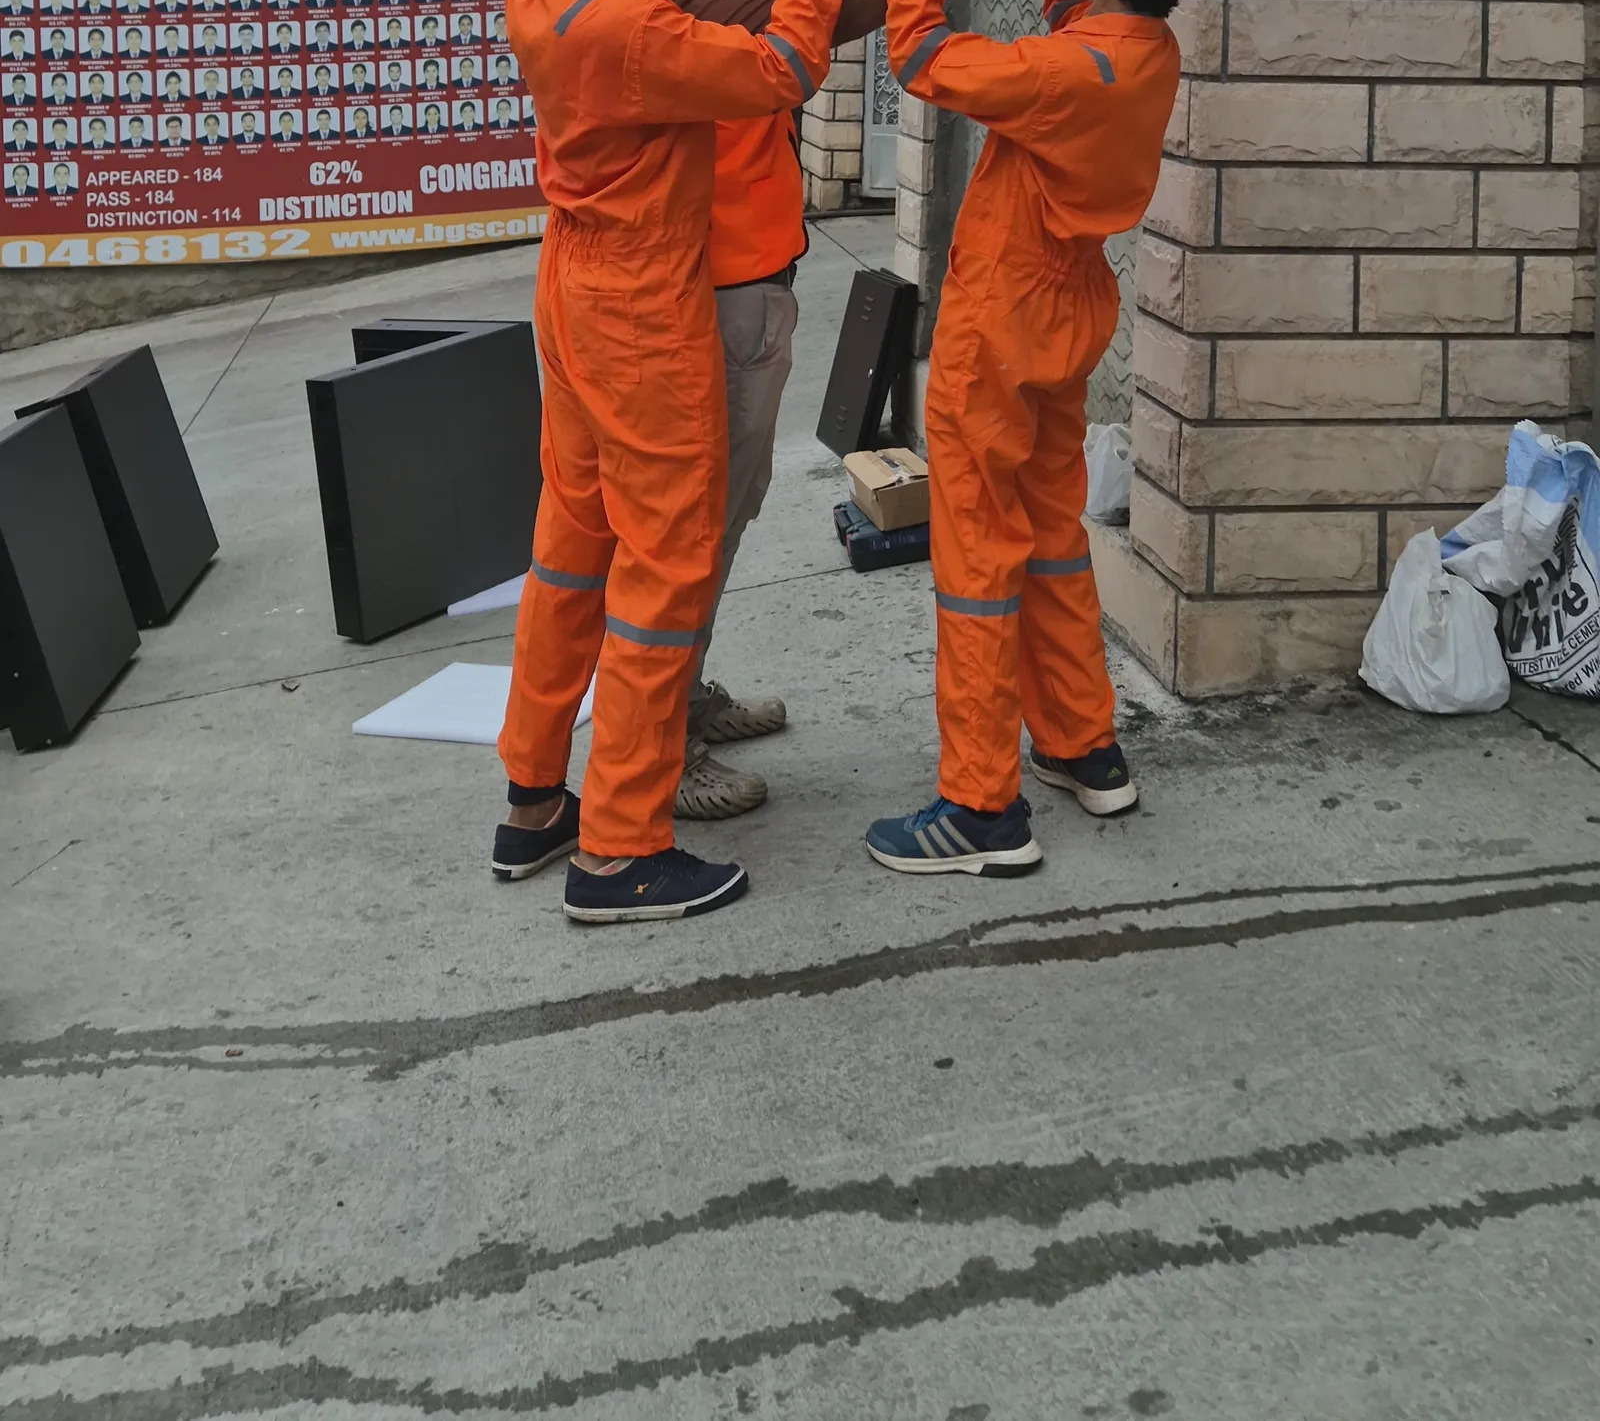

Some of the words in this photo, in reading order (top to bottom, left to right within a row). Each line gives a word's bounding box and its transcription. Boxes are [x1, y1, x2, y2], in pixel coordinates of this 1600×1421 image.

[86, 169, 179, 186] APPEARED
[193, 167, 223, 182] 184
[309, 160, 363, 186] 62%
[419, 157, 537, 194] CONGRAT
[86, 190, 131, 207] PASS
[145, 189, 175, 204] 184
[259, 189, 414, 222] DISTINCTION
[87, 209, 198, 228] DISTINCTION
[212, 207, 242, 222] 114
[1, 229, 311, 268] 0468132
[330, 213, 548, 250] www.bgscoll
